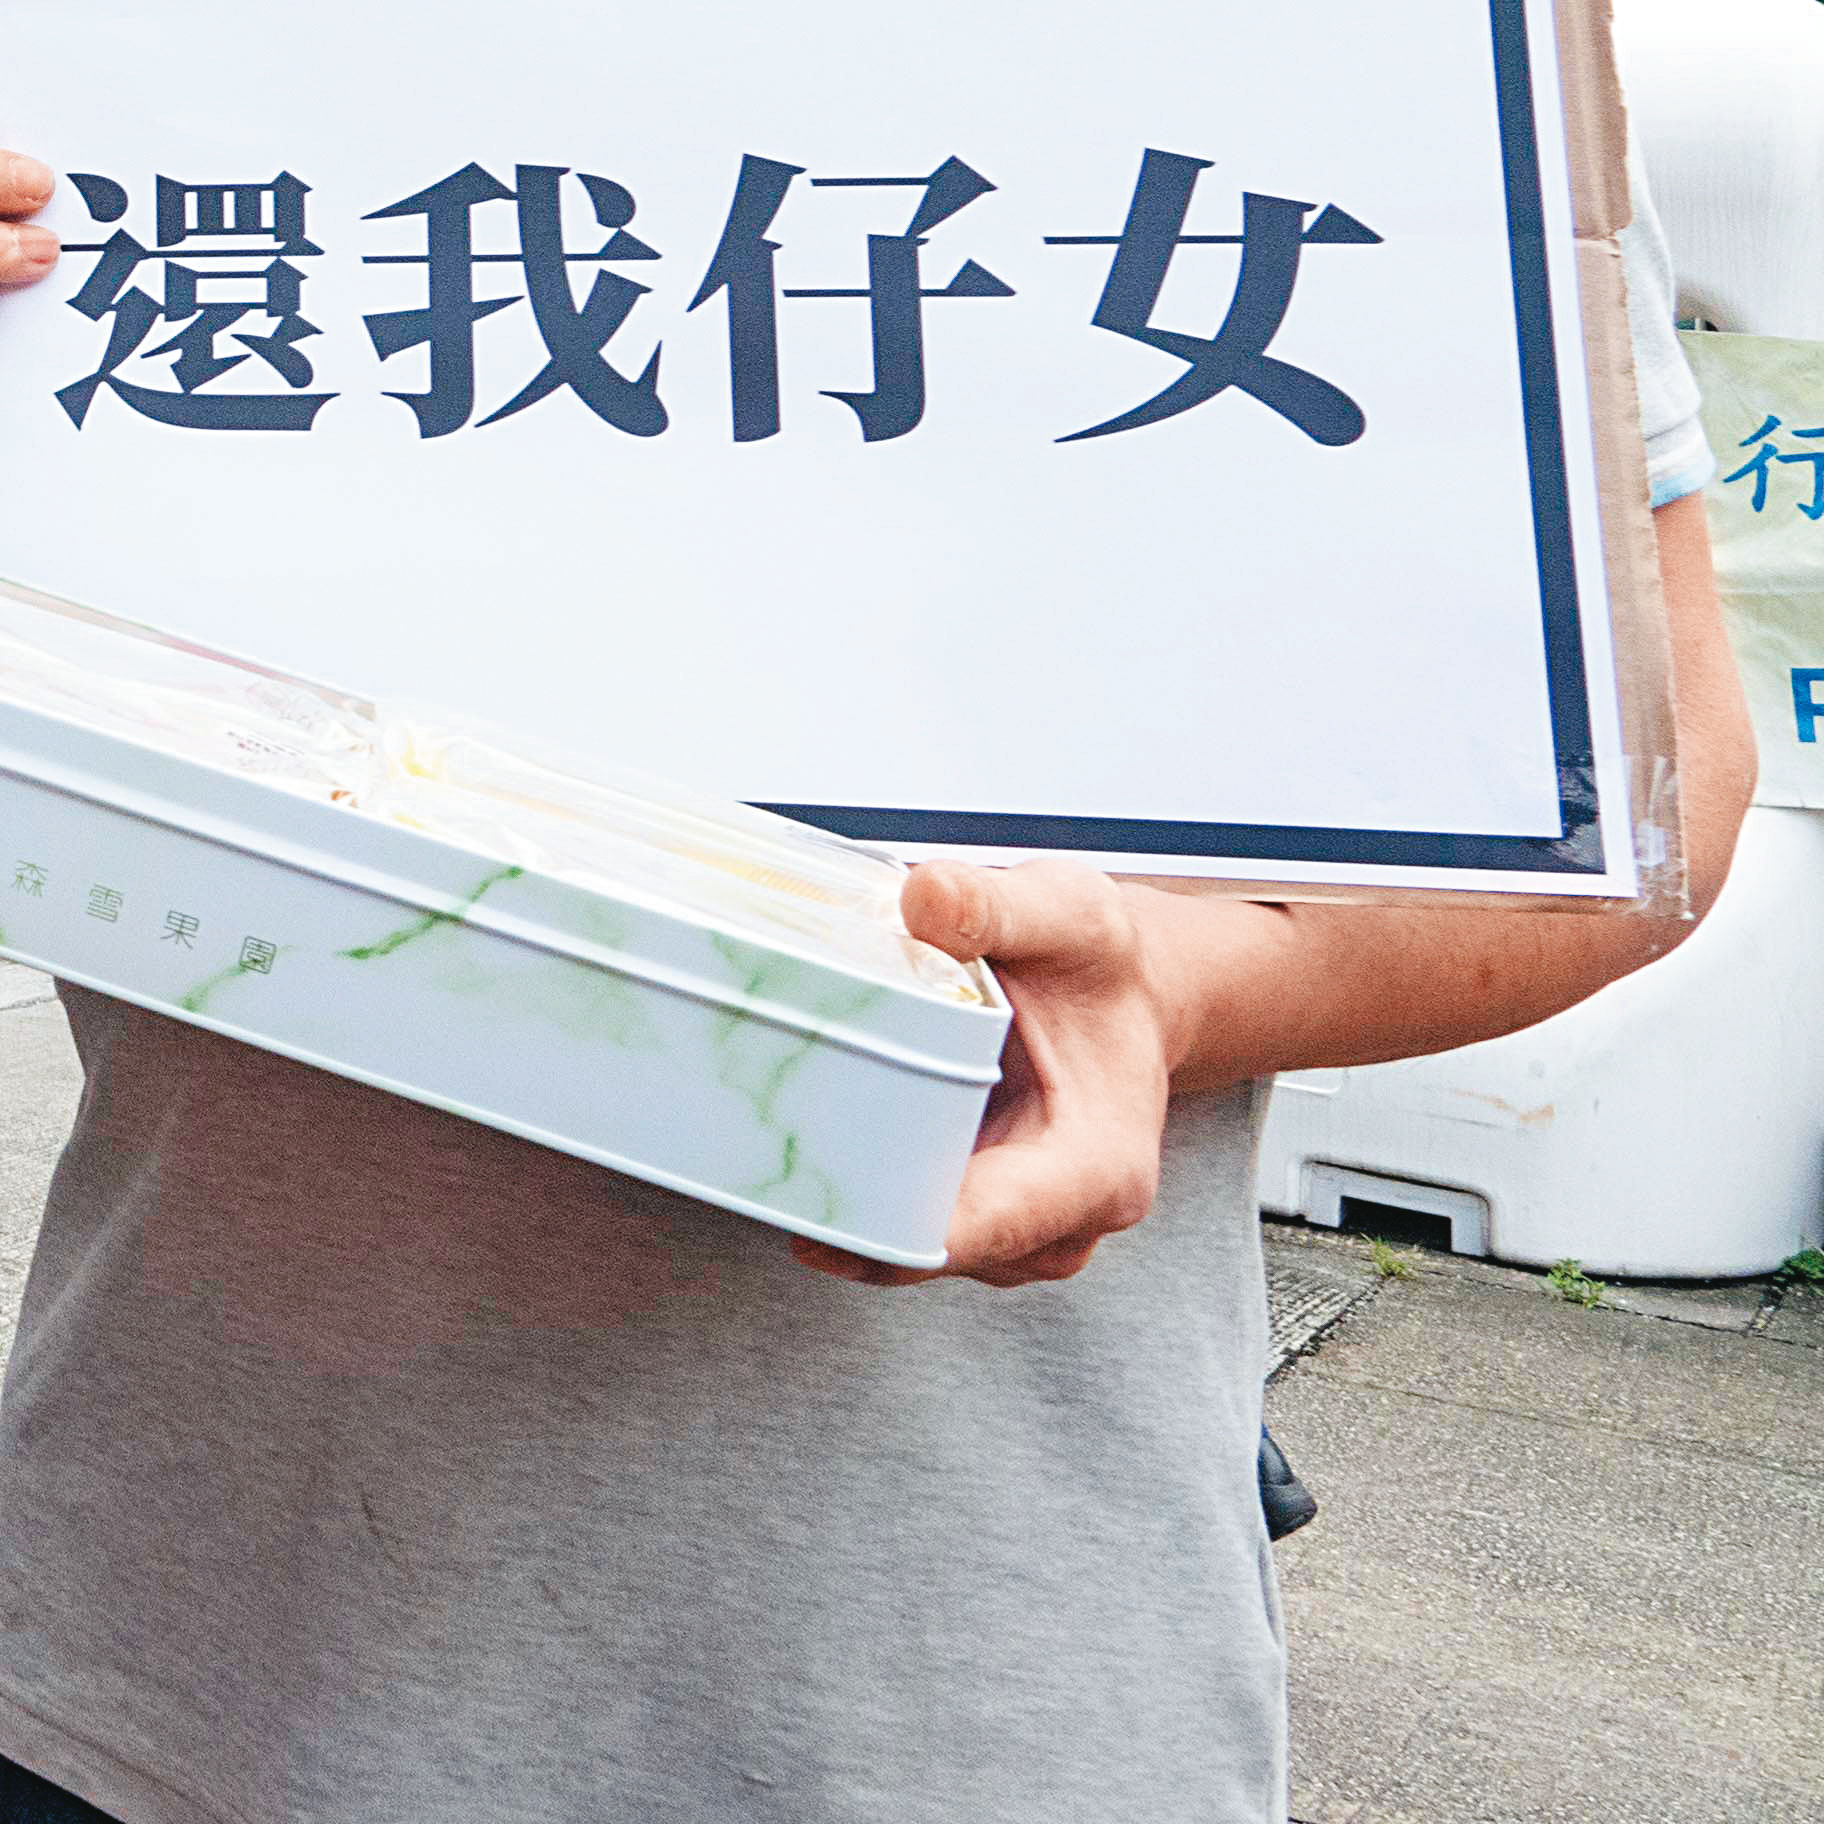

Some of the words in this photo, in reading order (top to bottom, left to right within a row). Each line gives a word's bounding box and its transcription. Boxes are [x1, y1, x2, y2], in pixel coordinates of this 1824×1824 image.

[53, 148, 1384, 447] 還我仔女
[10, 859, 278, 976] 森雪果園
